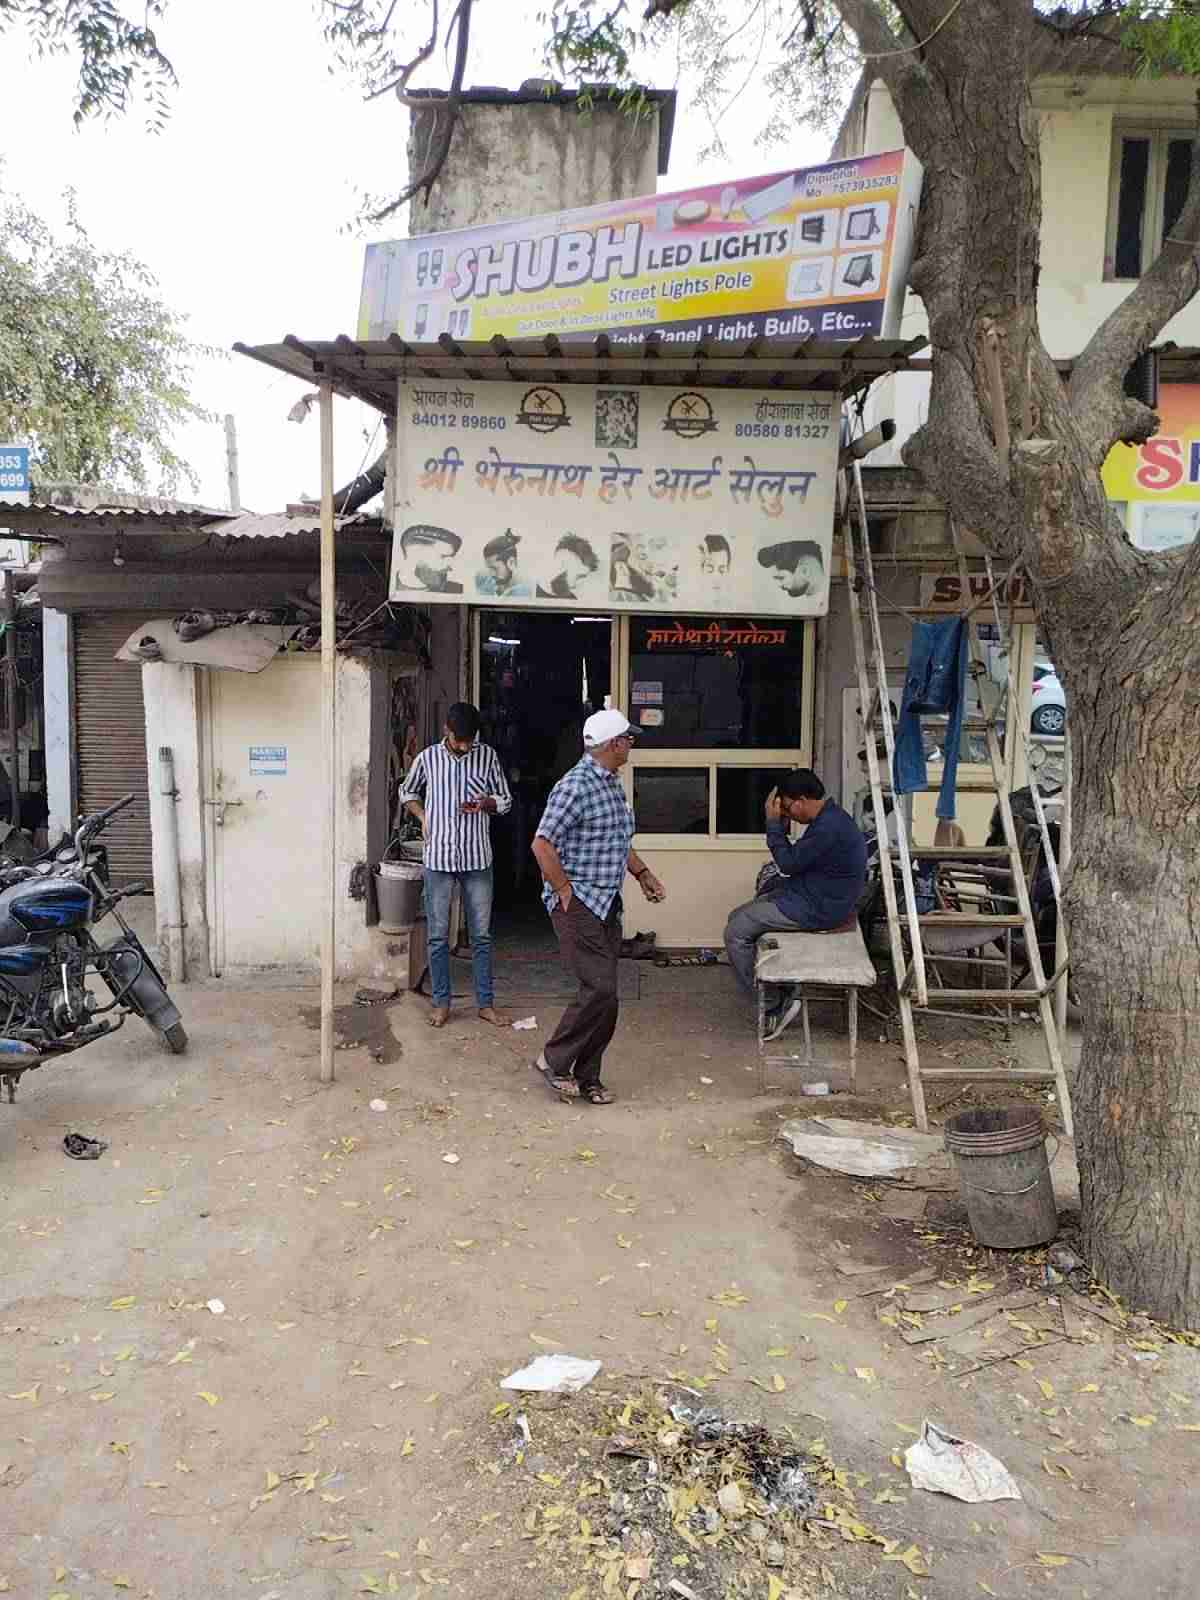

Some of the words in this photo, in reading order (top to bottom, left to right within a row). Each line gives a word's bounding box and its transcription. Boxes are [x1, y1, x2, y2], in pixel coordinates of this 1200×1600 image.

[451, 222, 642, 301] SHUBH
[647, 244, 692, 270] LED
[700, 229, 788, 262] LIGHTS
[609, 284, 657, 304] Street
[662, 277, 709, 299] Lights
[715, 272, 752, 291] Pole
[412, 413, 457, 428] 84012
[462, 415, 506, 430] 89860
[735, 423, 780, 438] 80580
[784, 425, 829, 439] 81327
[416, 446, 464, 493] श्री
[598, 452, 643, 505] हेर
[648, 455, 721, 503] आर्ट
